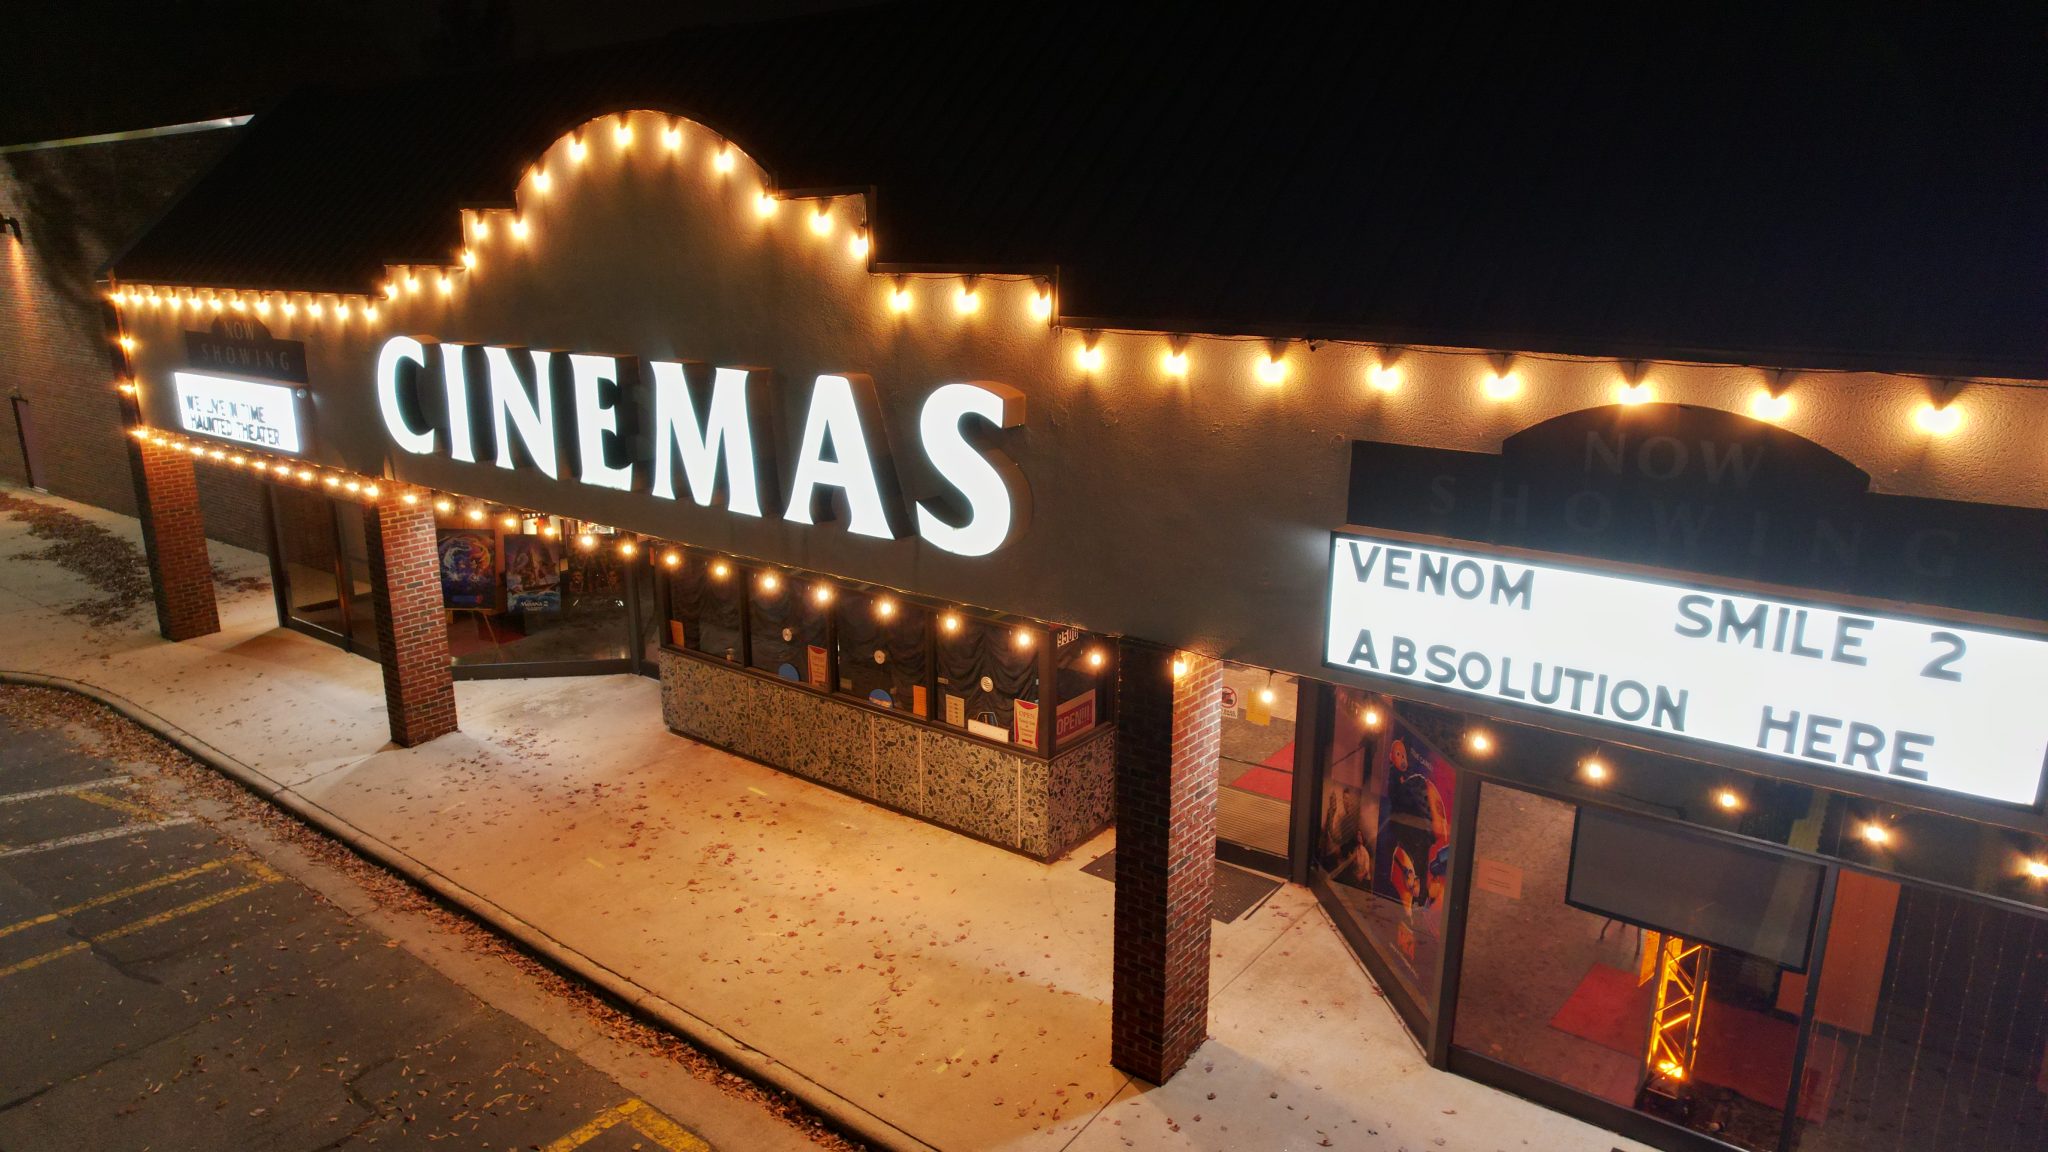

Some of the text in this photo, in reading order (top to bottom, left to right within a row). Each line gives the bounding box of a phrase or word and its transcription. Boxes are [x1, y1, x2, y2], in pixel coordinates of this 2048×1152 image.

[202, 343, 289, 370] SHOWING
[224, 321, 255, 340] NOW
[185, 394, 201, 411] WE
[207, 398, 226, 416] LVE
[191, 415, 281, 446] HAUNTED THEATER
[377, 335, 1012, 557] CINEMAS
[1584, 431, 1766, 492] NOW
[1430, 474, 1963, 578] SHOWING
[1348, 541, 1967, 683] VENOM SMILE 2
[1347, 628, 1936, 783] ABSOLUTION HERE
